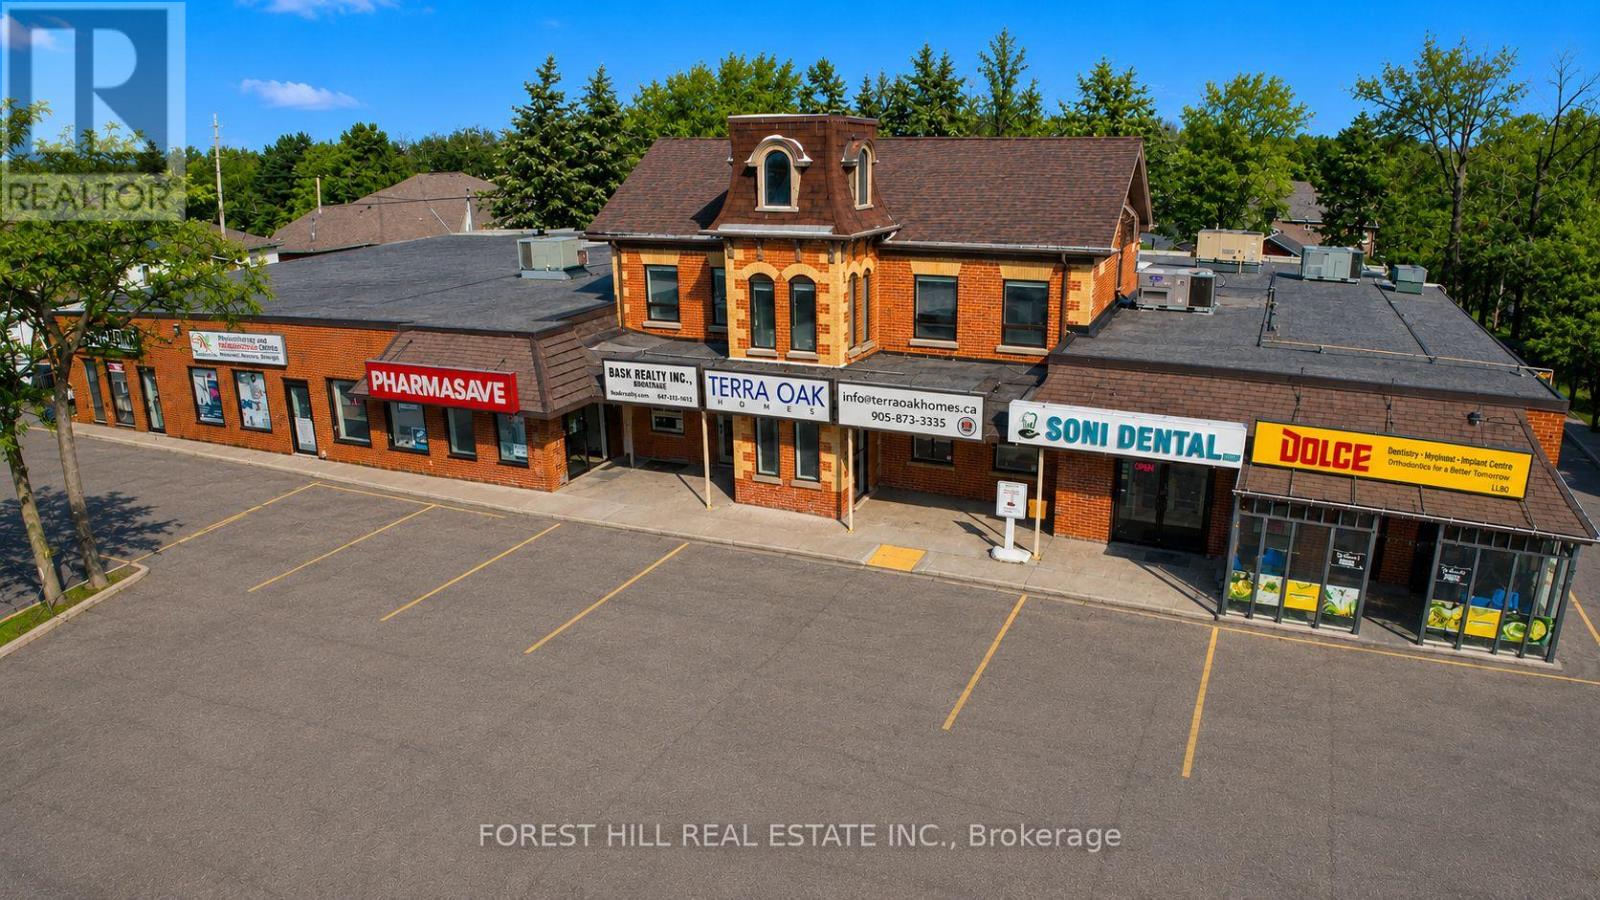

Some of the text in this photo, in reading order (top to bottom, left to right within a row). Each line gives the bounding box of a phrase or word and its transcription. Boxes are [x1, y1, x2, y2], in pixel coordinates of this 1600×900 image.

[370, 370, 506, 405] PHARMASAVE
[609, 367, 692, 385] BASK REALTY INC.,
[708, 375, 826, 407] TERRA OAK
[843, 391, 977, 416] info@terraoakhomes.ca
[871, 410, 946, 429] 905-873-3335
[1045, 415, 1223, 460] SONI DENTAL
[1280, 428, 1373, 472] DOLCE
[1388, 446, 1420, 459] Dentistry
[1460, 456, 1488, 467] Implant
[1489, 460, 1513, 471] Centre
[1388, 458, 1432, 471] Orthodontics
[1432, 463, 1442, 472] for
[1450, 466, 1472, 477] Better
[1474, 470, 1510, 481] Tomorrow
